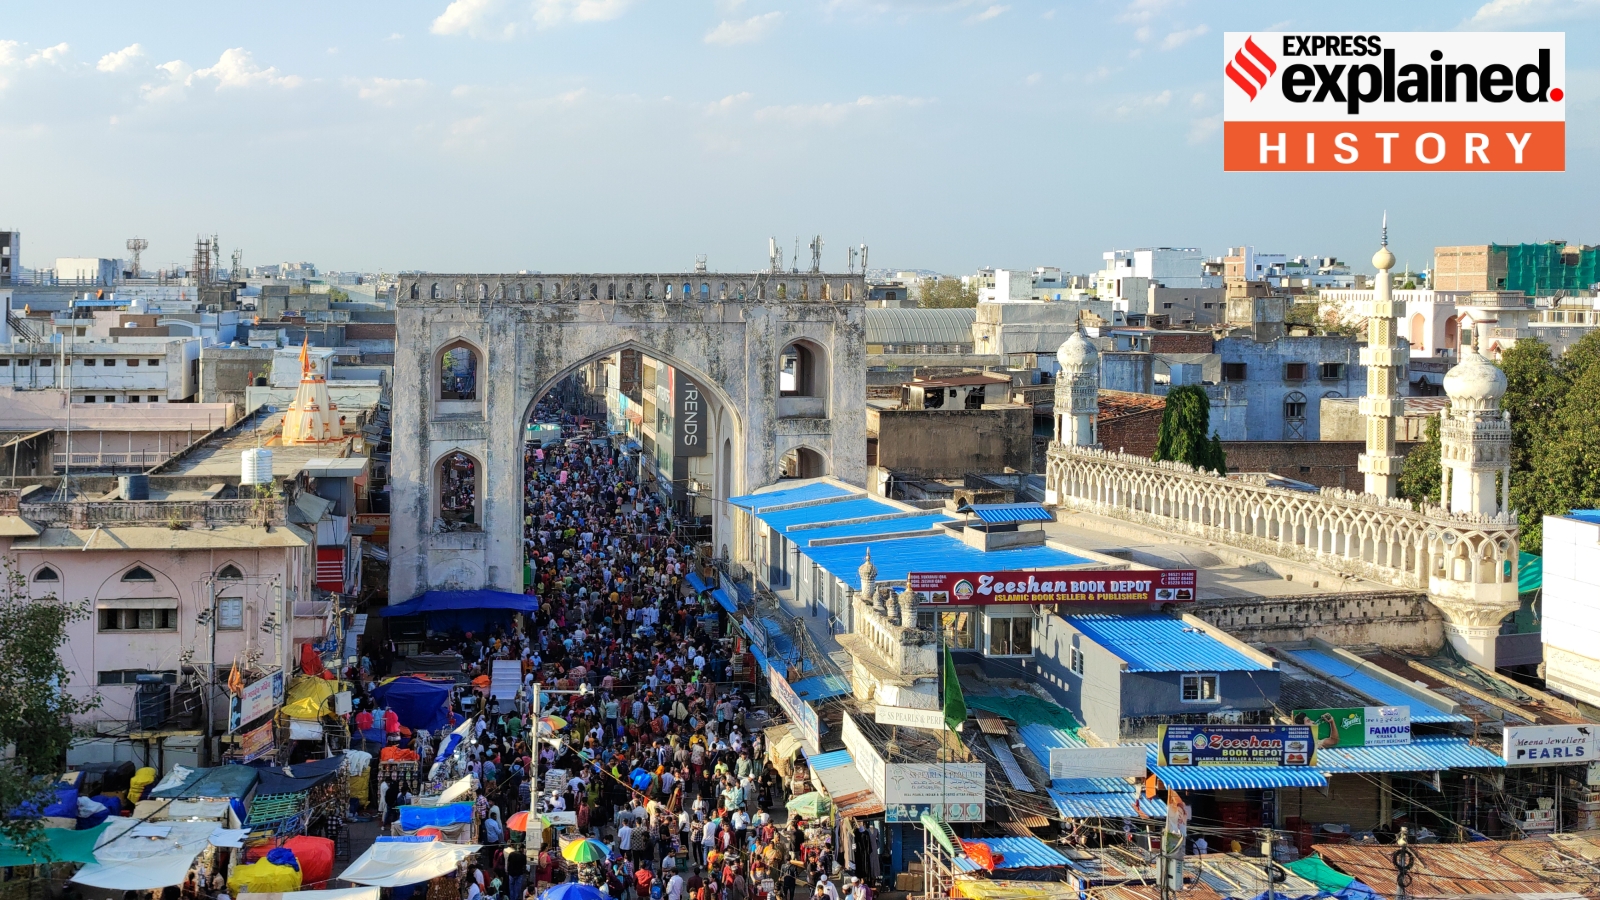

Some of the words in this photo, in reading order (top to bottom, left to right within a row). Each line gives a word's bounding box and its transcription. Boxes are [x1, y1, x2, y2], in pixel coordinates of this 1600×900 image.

[976, 574, 1068, 596] Zeeshan
[1070, 580, 1106, 592] BOOK
[1110, 580, 1152, 592] DEPOT
[1032, 594, 1056, 602] BOOK
[1056, 593, 1086, 601] SELLER
[1097, 592, 1148, 600] PUBLISHERS
[887, 712, 894, 720] SS
[896, 712, 920, 722] PEARLS
[920, 714, 926, 724] &
[1342, 714, 1361, 729] Sprite
[1370, 726, 1410, 734] FAMOUS
[1208, 734, 1282, 750] Zeeshan
[1514, 738, 1544, 746] Meena
[1545, 736, 1586, 745] Jewellers
[1516, 746, 1585, 760] PEARLS
[918, 770, 942, 778] PEARLS
